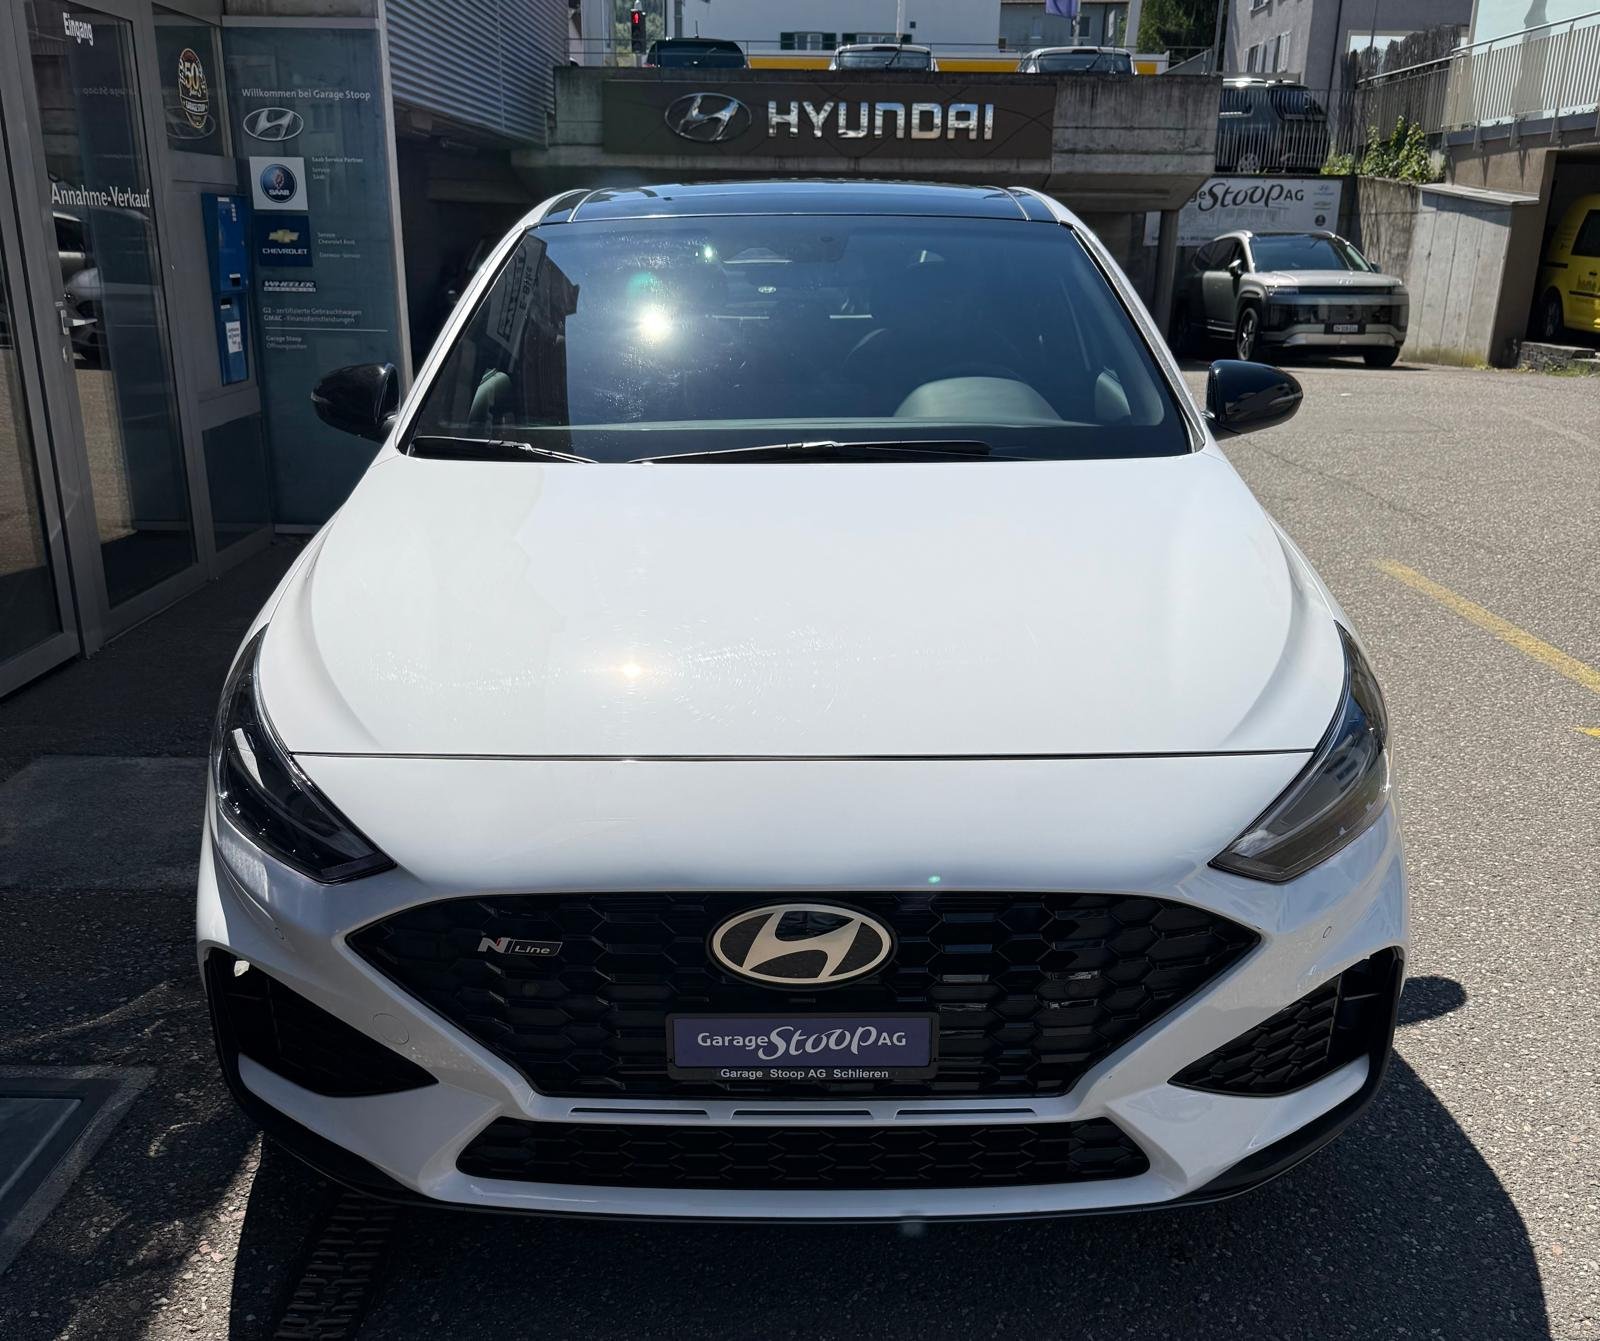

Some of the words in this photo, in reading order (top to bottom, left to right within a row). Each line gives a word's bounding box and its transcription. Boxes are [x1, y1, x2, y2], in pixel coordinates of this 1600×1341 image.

[63, 12, 94, 46] Eingang
[242, 88, 297, 98] Willkommen
[298, 89, 312, 98] bei
[313, 90, 344, 101] Garage
[345, 90, 371, 101] Stoop
[767, 100, 993, 141] HYUNDAI
[51, 182, 151, 208] Annahme-Verkauf
[1198, 182, 1284, 212] Stoop
[1284, 189, 1304, 201] AG
[514, 945, 550, 954] Line
[697, 1032, 769, 1050] Garage
[757, 1025, 878, 1060] Stoop
[877, 1032, 906, 1046] AG
[720, 1068, 763, 1080] Garage
[769, 1068, 805, 1079] Stoop
[808, 1069, 826, 1079] AG
[833, 1068, 889, 1079] Schlieren
